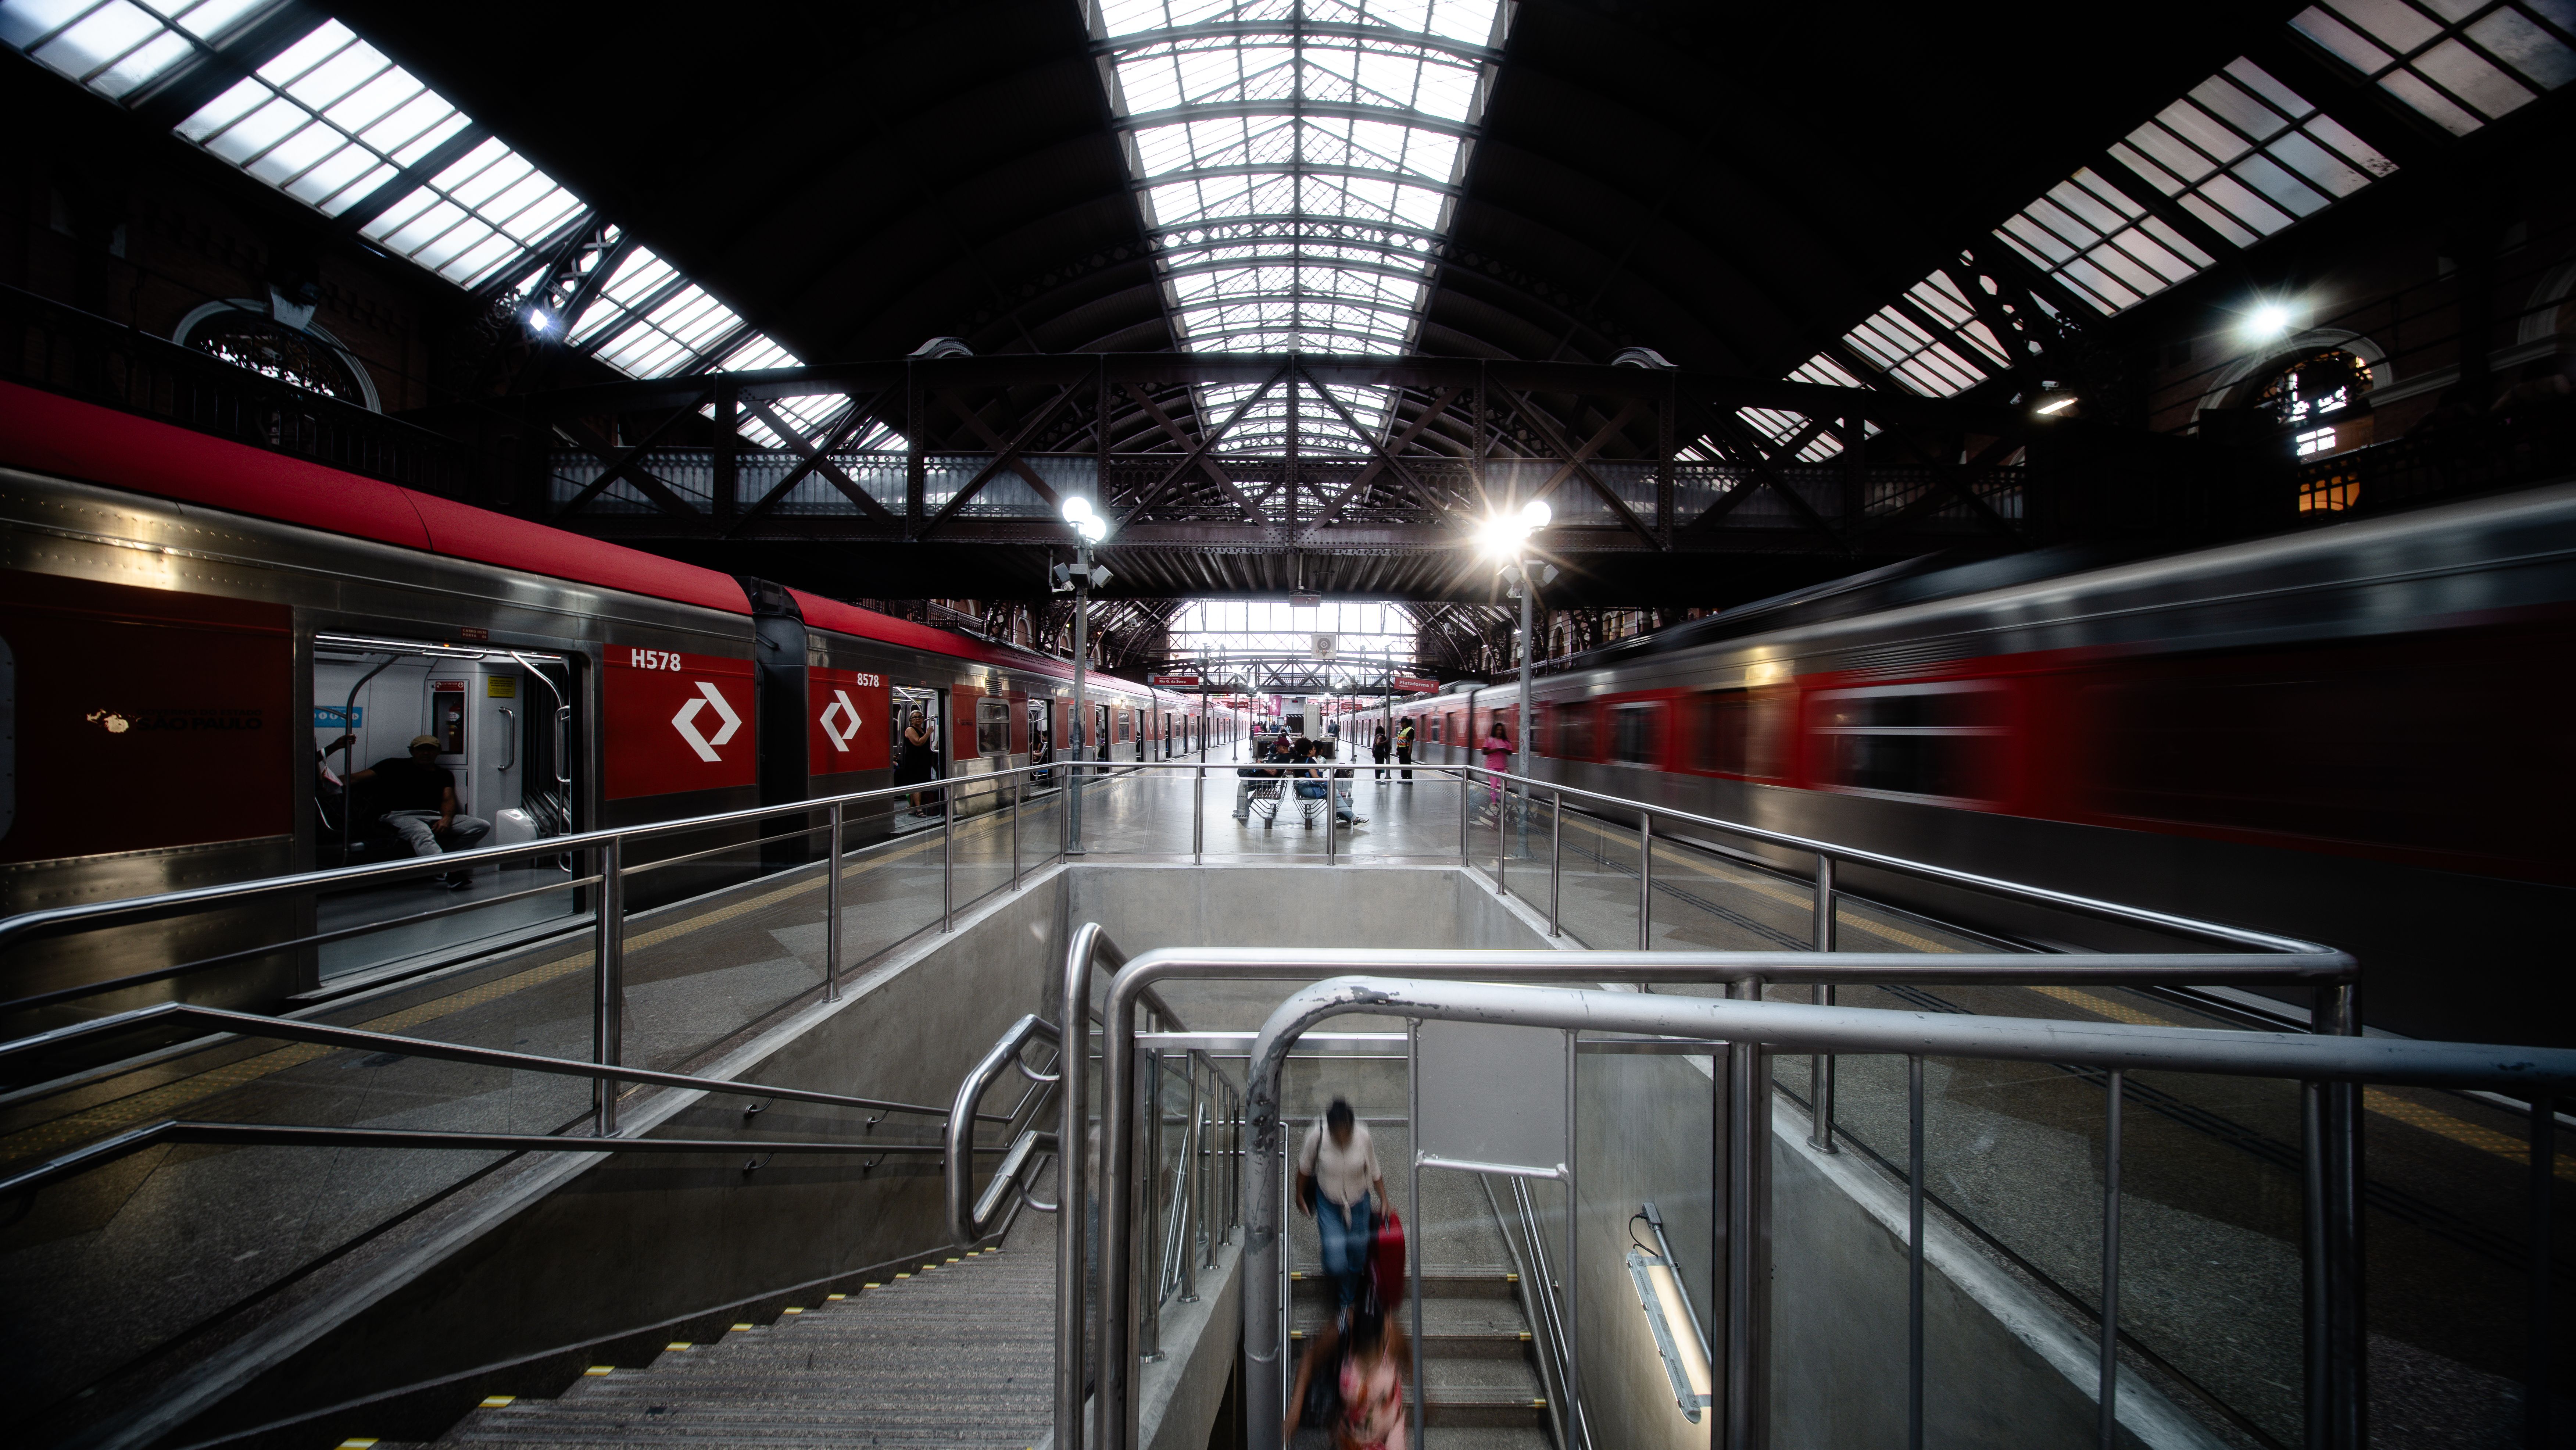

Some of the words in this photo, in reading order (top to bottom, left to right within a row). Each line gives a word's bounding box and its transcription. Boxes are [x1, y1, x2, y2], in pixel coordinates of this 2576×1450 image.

[631, 649, 681, 671] H578
[857, 673, 880, 687] 8578
[136, 715, 187, 731] SÃO
[192, 717, 263, 731] PAULO
